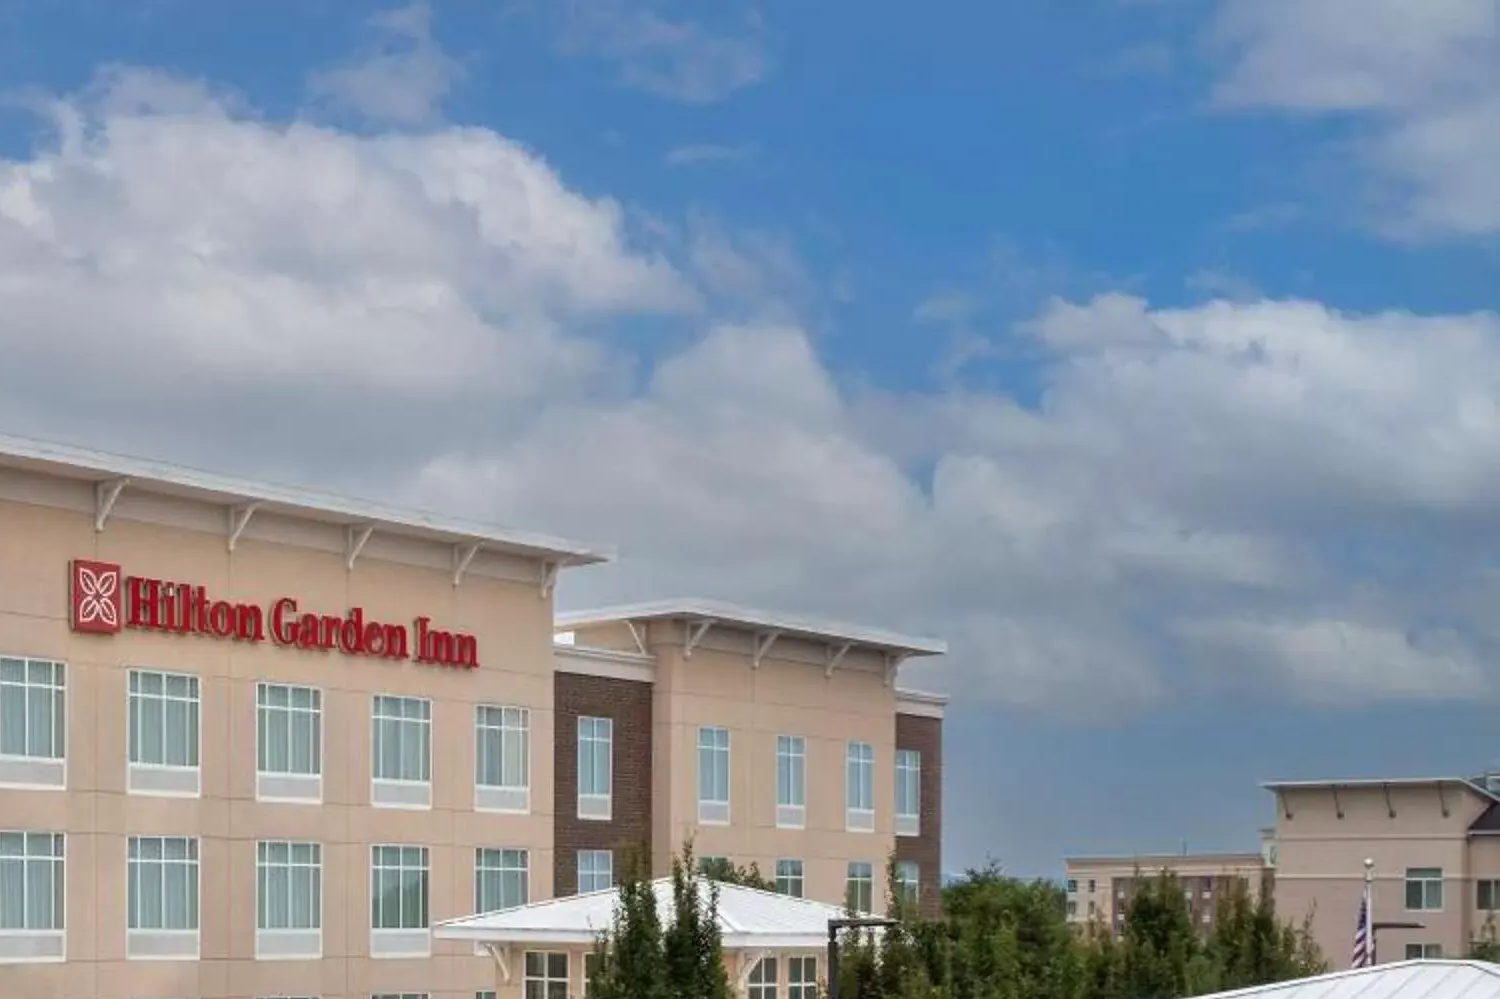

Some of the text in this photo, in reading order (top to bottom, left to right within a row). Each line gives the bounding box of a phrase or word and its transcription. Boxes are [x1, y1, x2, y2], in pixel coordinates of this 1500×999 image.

[127, 577, 478, 667] Hilton Garden Inn
